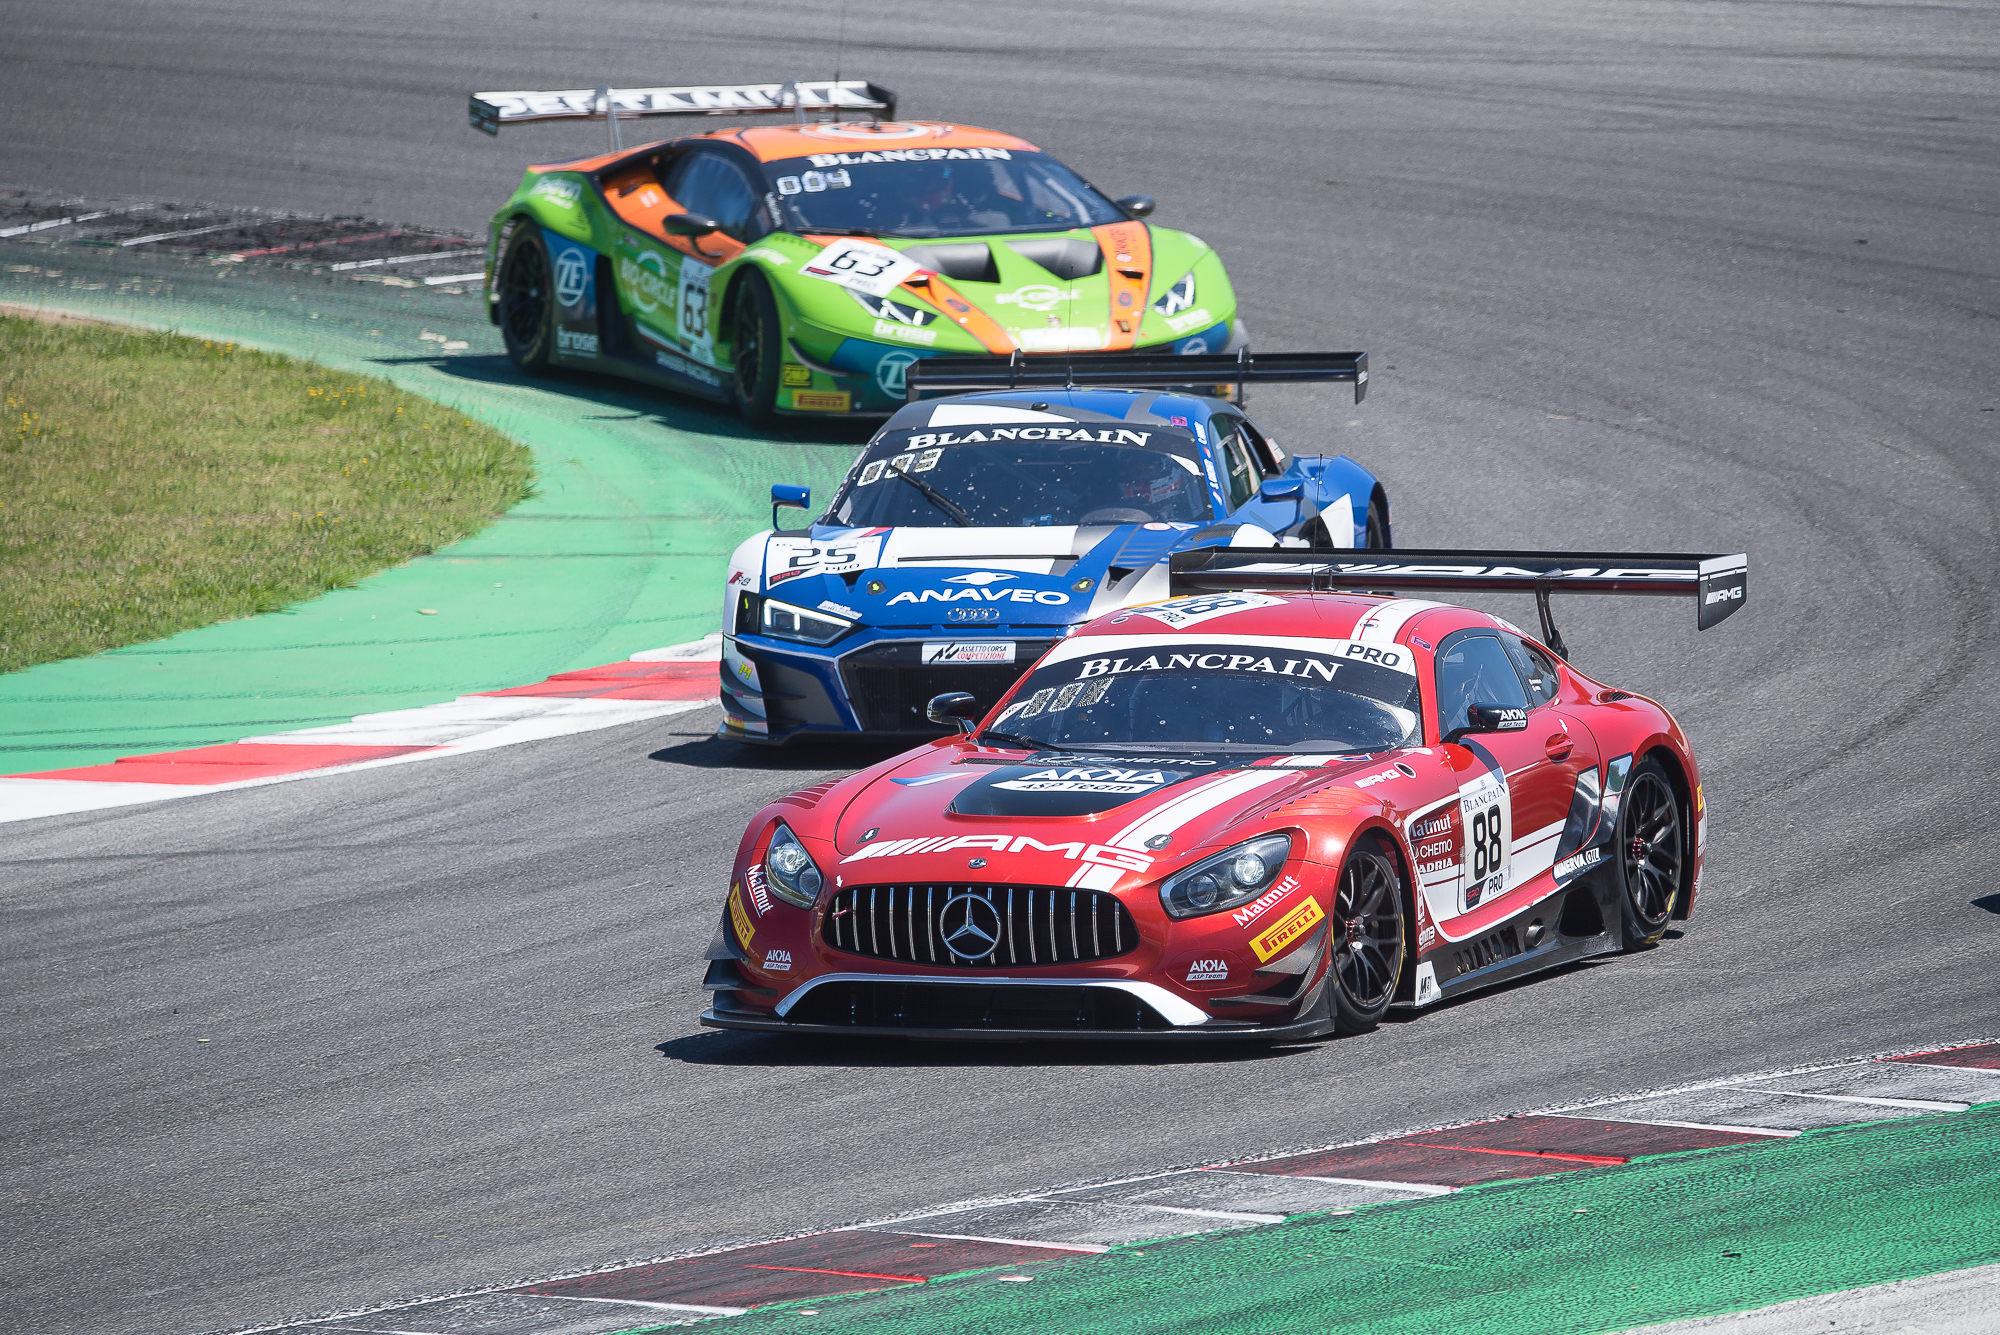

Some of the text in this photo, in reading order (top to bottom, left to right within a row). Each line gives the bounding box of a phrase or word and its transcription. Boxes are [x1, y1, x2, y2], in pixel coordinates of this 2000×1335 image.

[806, 148, 1012, 168] BLANCPAIN
[830, 250, 896, 276] 63
[556, 258, 585, 294] ZF
[683, 283, 707, 338] 63
[558, 324, 598, 351] brose
[873, 319, 937, 342] brose
[905, 428, 1152, 451] BLANCPAIN
[789, 546, 858, 568] 25
[886, 588, 1070, 606] ANAVEO
[957, 652, 1006, 660] COMPETIZIONE
[960, 645, 987, 653] ASSETTO
[1345, 643, 1400, 667] PRO
[1075, 652, 1343, 682] BLANCPAIN
[1018, 768, 1166, 784] AKKA
[1066, 782, 1135, 792] Team
[1463, 783, 1506, 813] BLANCPAIN
[933, 835, 1156, 873] AMG
[1420, 838, 1453, 859] CHEMO
[1473, 803, 1502, 881] 88
[1418, 857, 1454, 875] ADRIA
[1553, 848, 1600, 880] MINERVA OIL
[747, 863, 774, 916] Matmut
[1466, 872, 1504, 901] SRO PRO
[1232, 874, 1299, 927] Matmut
[731, 891, 751, 940] PIRELLI
[1259, 904, 1317, 954] PIRELLI
[765, 949, 792, 962] AKKA
[1189, 959, 1229, 973] AKKA
